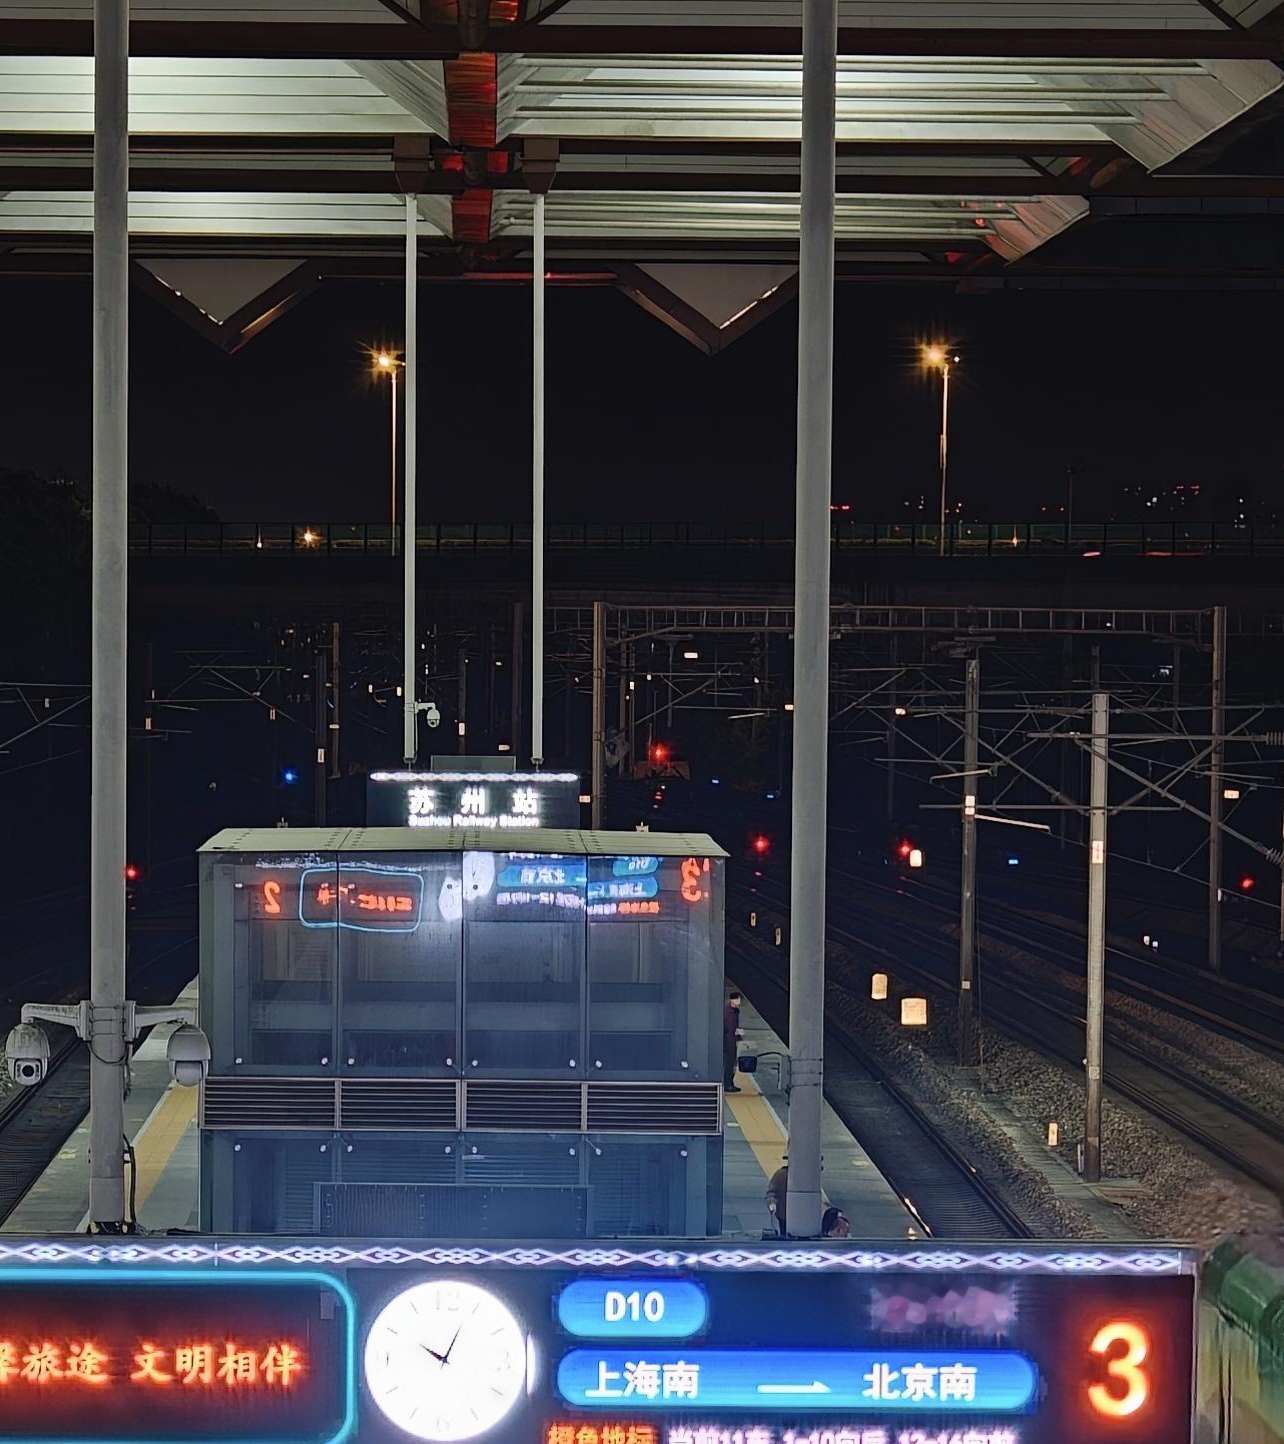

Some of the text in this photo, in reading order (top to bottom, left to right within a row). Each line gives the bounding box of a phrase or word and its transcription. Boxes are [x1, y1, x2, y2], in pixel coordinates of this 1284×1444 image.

[408, 786, 538, 815] 苏州站
[408, 814, 539, 829] Suzhou Railway Station
[604, 1291, 664, 1323] D10
[130, 1341, 302, 1385] 文明相伴
[584, 1360, 977, 1401] 上海南 北京南
[1087, 1321, 1149, 1417] 3
